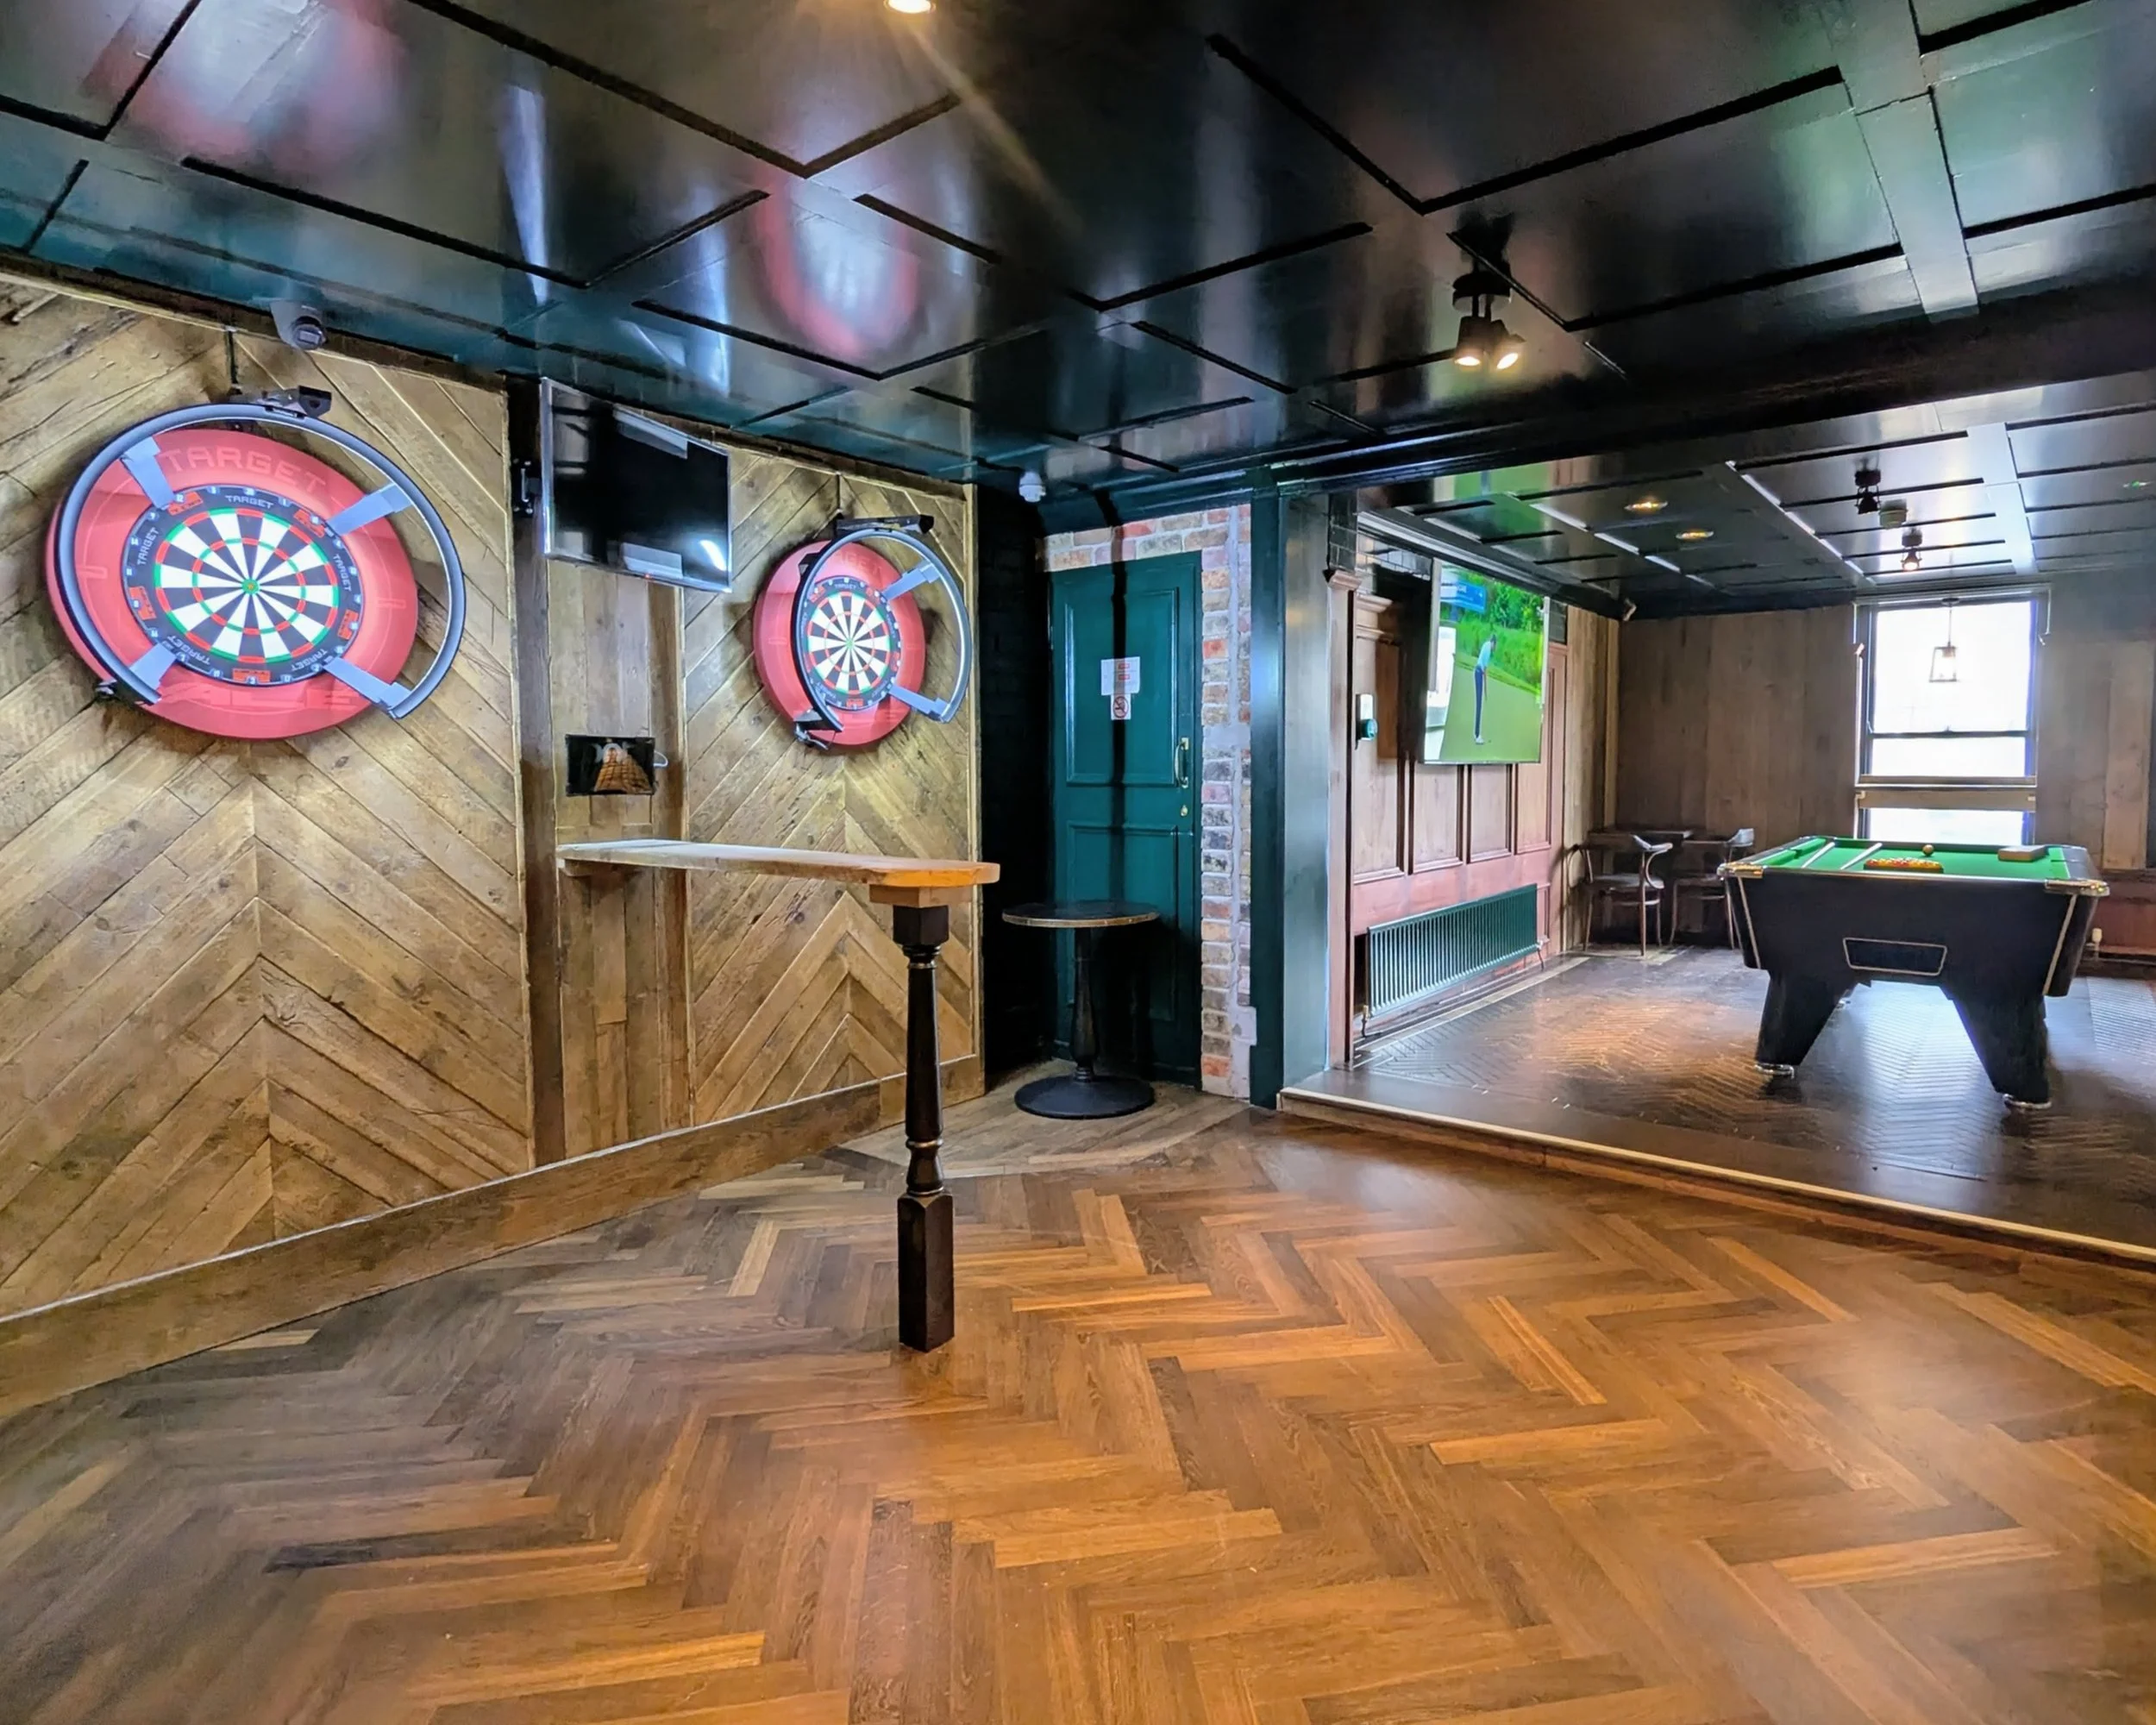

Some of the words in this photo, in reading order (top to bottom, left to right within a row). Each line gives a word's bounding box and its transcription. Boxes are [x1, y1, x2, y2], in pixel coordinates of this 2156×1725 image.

[156, 446, 326, 493] TARGET
[224, 494, 274, 509] TARGET
[136, 526, 160, 566] TARGET
[332, 553, 353, 593] TARGET
[166, 635, 211, 666] TARGET
[291, 648, 329, 672] TARGET
